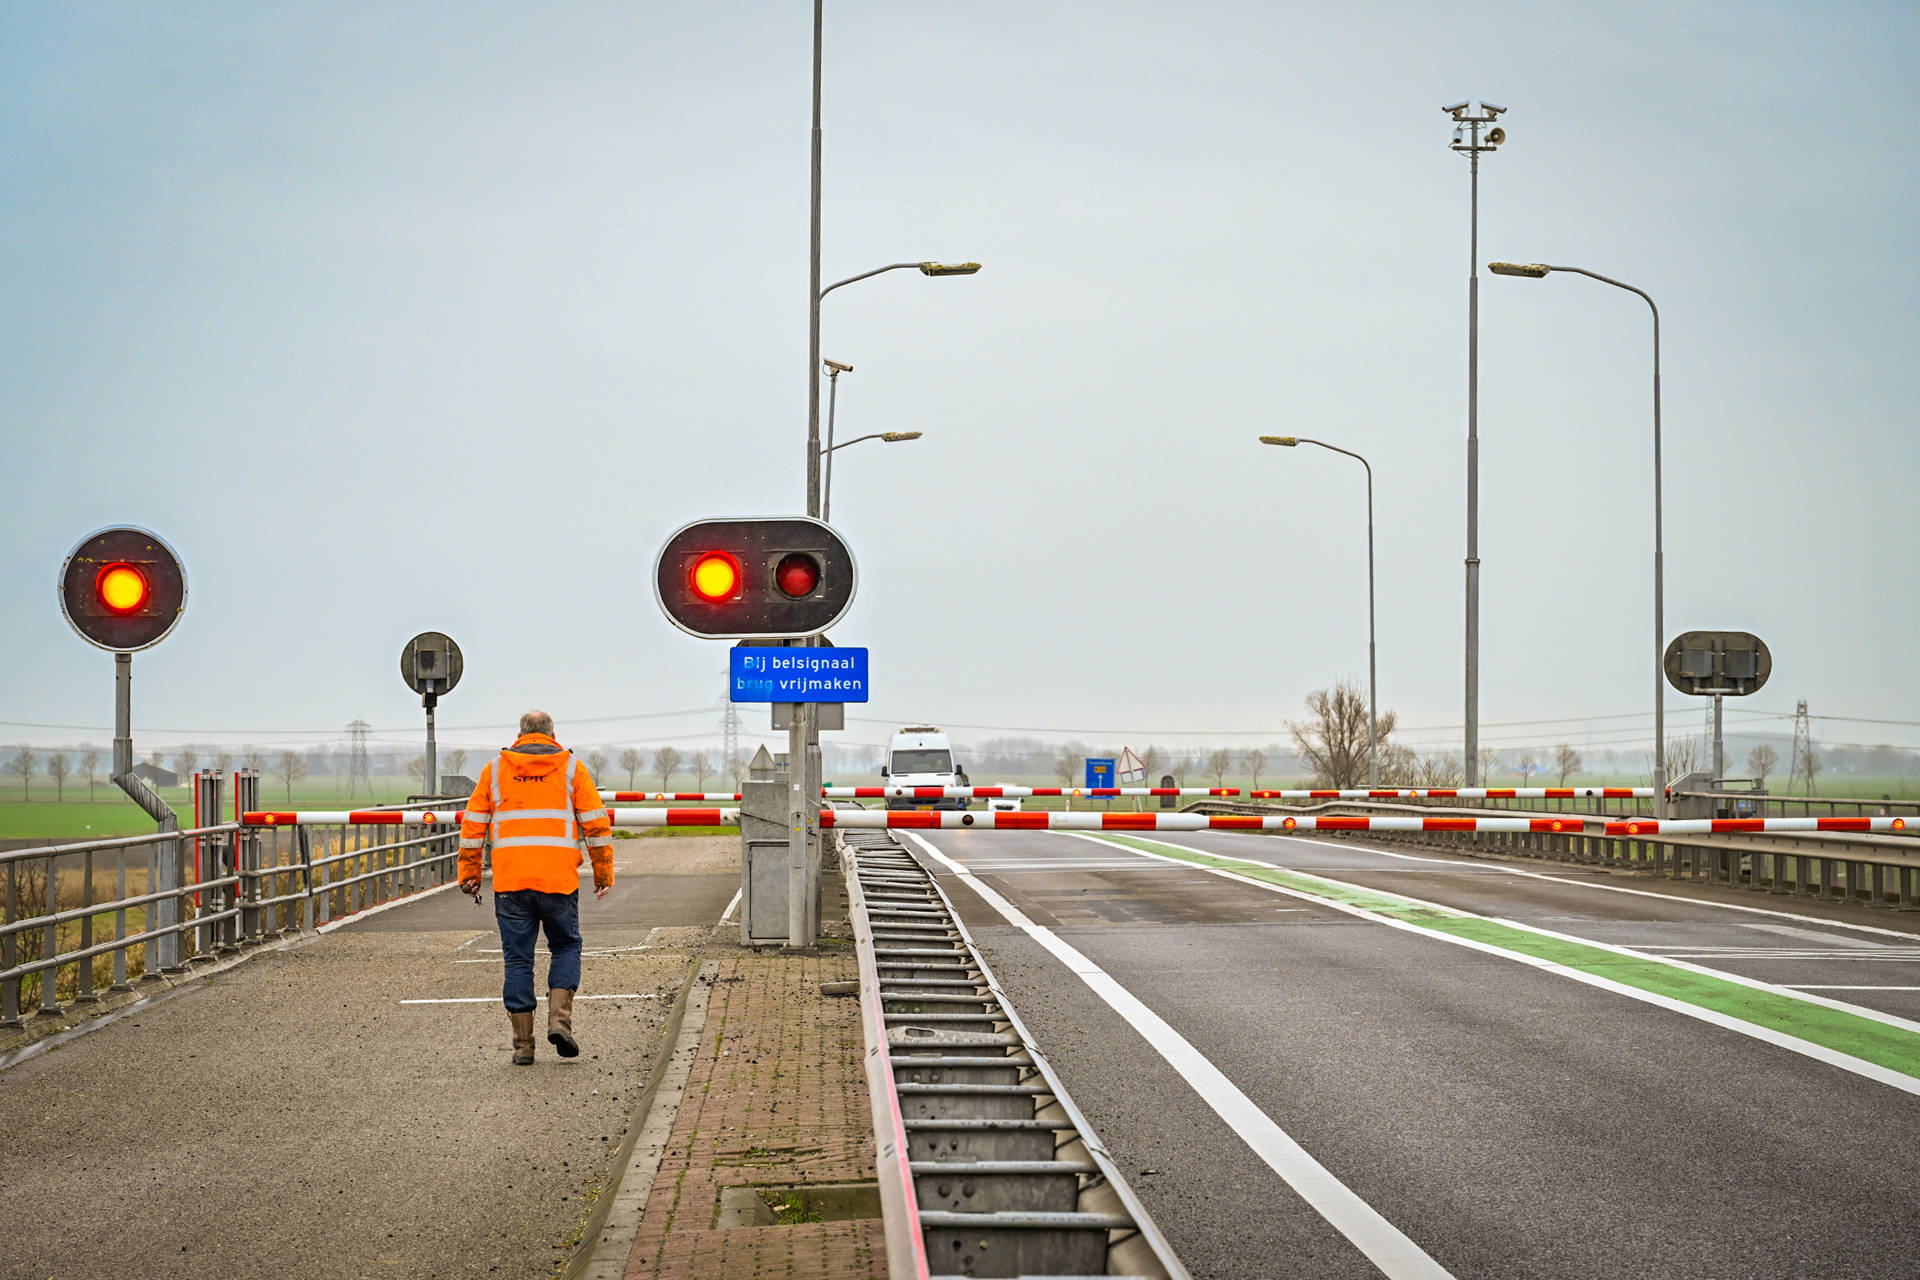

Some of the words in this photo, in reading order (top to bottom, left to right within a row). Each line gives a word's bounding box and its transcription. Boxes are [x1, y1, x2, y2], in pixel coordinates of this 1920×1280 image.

[744, 656, 766, 672] Bij
[773, 656, 855, 672] belsignaal
[737, 677, 773, 692] brug
[779, 677, 862, 693] vrijmaken
